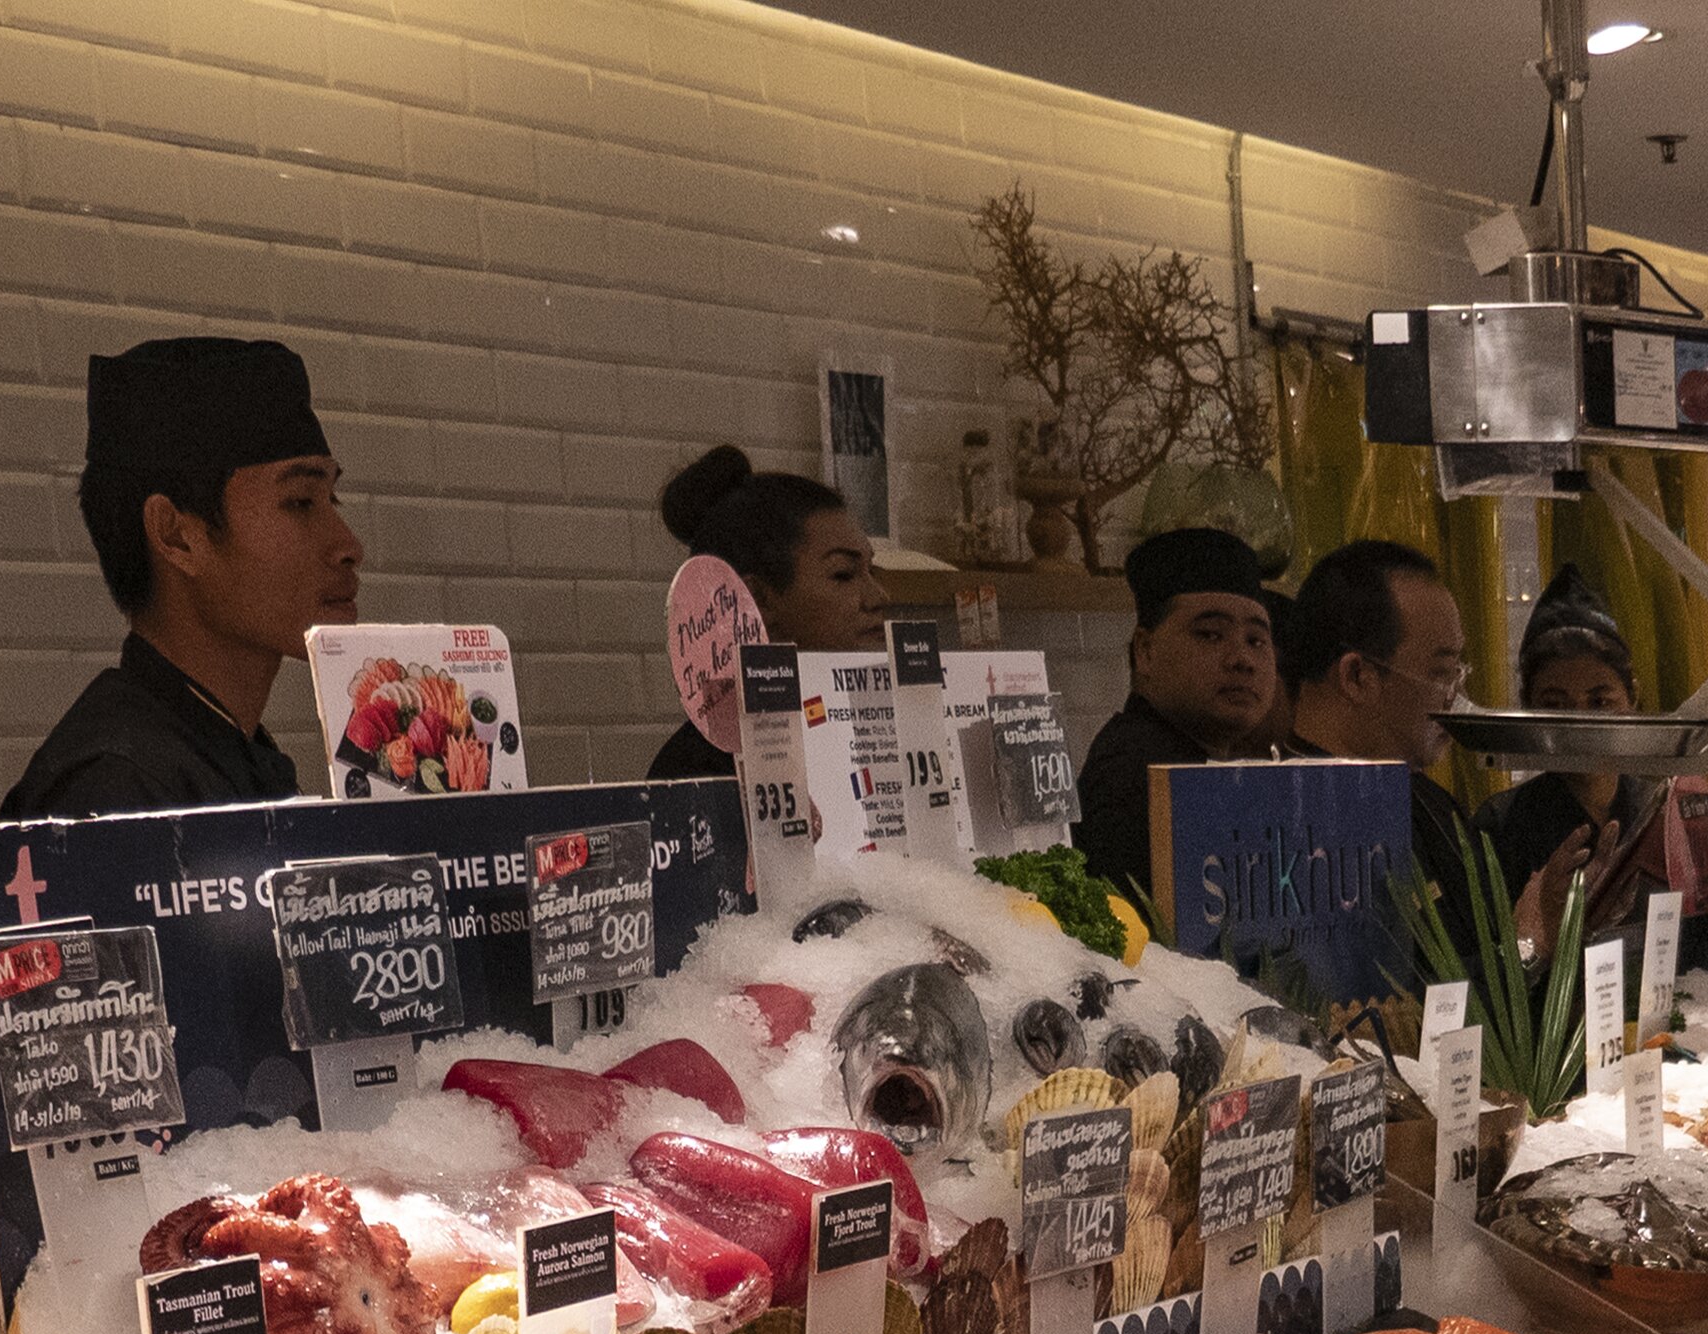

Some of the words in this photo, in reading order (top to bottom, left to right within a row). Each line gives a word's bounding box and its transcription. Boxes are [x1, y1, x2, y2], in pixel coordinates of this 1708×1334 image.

[453, 629, 491, 648] FREE!
[442, 650, 476, 662] SASHIMI
[476, 650, 508, 662] SLICING
[746, 667, 778, 681] Norwegian
[832, 668, 869, 692] NEW
[828, 708, 856, 722] FRESH
[954, 704, 986, 718] BREAM
[755, 782, 797, 822] 335
[441, 858, 489, 890] THE
[602, 911, 649, 958] 980
[350, 944, 446, 1010] 2,890
[19, 1034, 58, 1060] Tako
[84, 1028, 163, 1098] 1,430
[825, 1211, 845, 1226] Fresh
[847, 1203, 886, 1219] Norwegian
[834, 1222, 854, 1239] Fjord
[856, 1218, 876, 1231] Trout
[532, 1245, 558, 1262] Fresh
[560, 1234, 608, 1256] Norwegian
[537, 1260, 570, 1277] Aurora
[571, 1251, 605, 1268] Salmon
[156, 1289, 221, 1313] Tasmanian
[223, 1281, 256, 1299] Trout
[194, 1305, 224, 1323] Fillet
